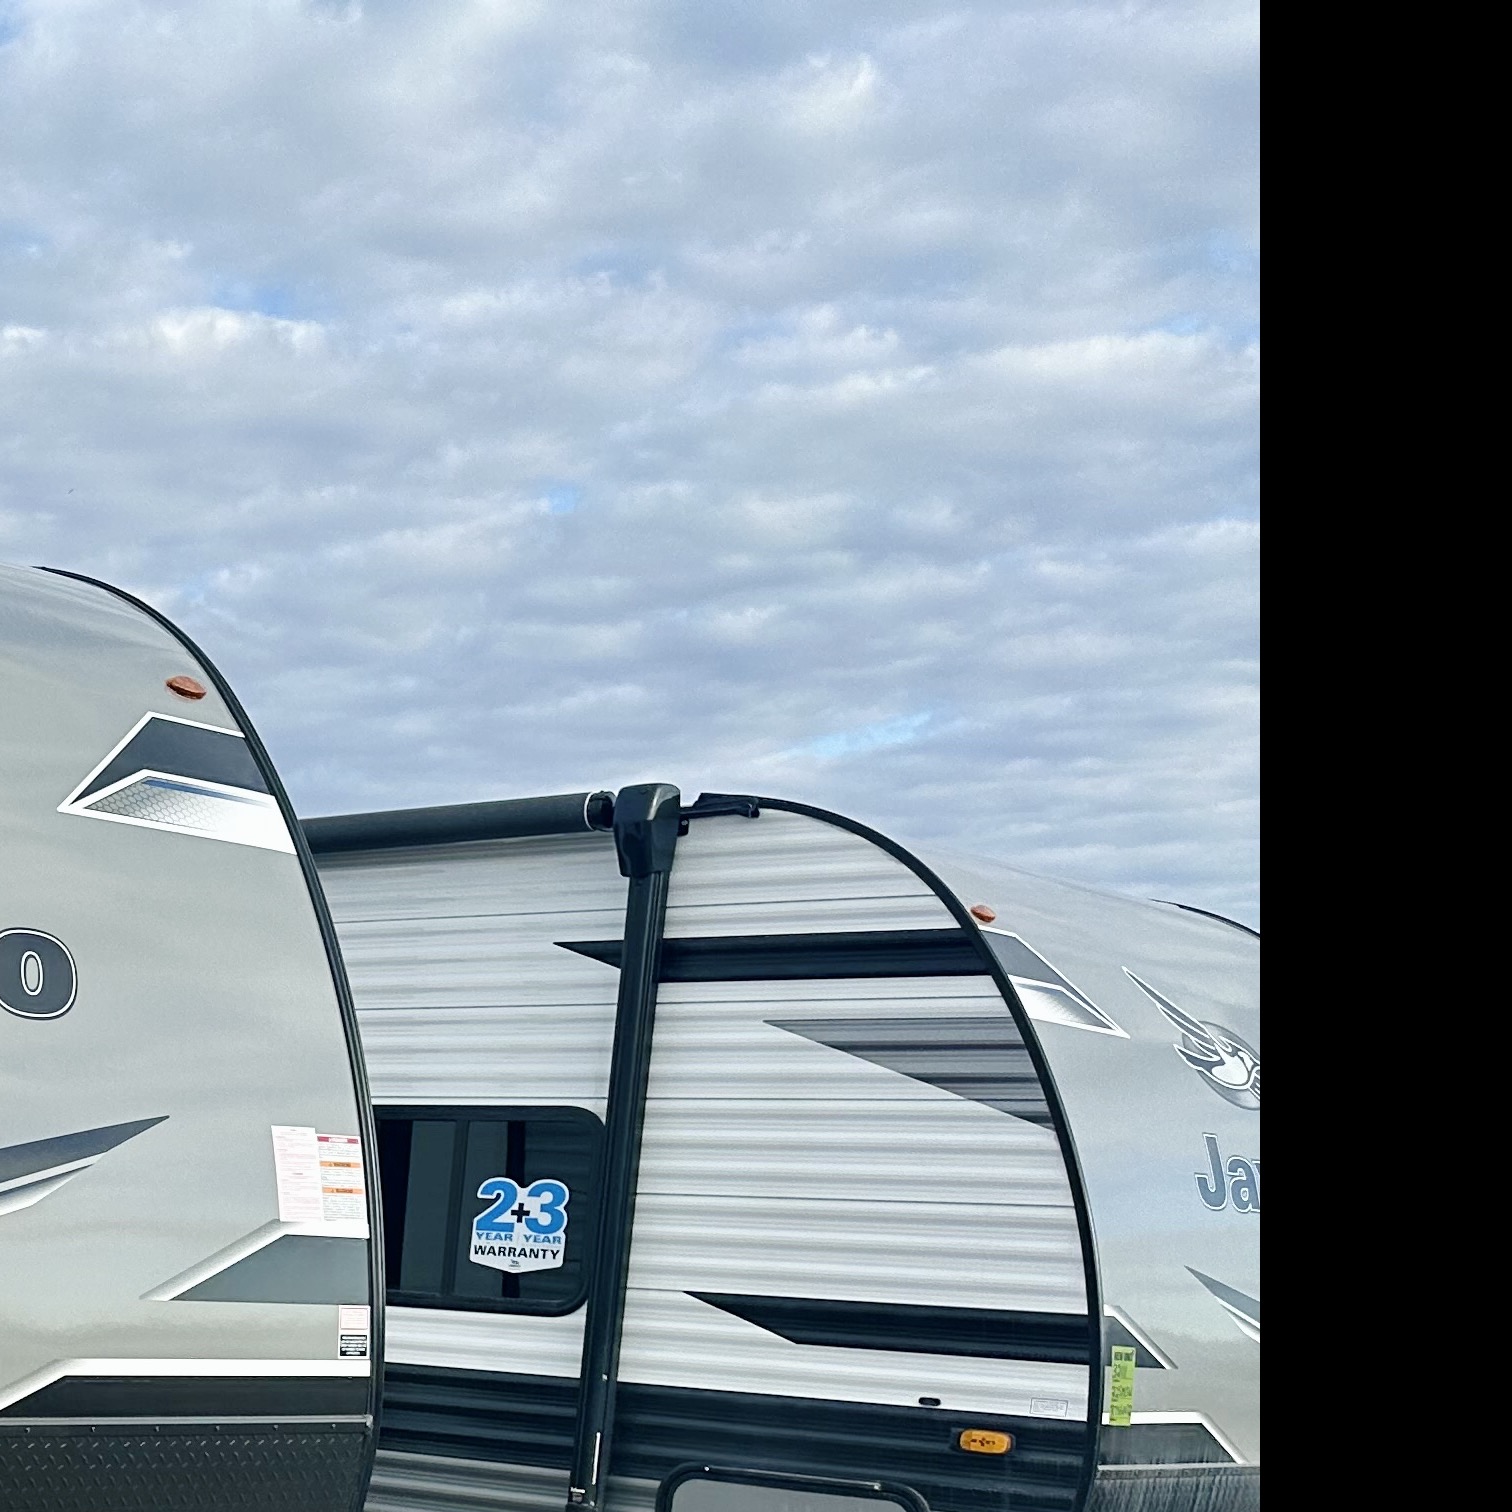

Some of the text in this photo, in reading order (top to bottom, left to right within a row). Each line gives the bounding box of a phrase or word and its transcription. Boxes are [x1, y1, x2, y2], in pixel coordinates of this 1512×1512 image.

[1194, 1132, 1260, 1214] Ja
[476, 1232, 562, 1245] YEAR YEAR
[474, 1245, 560, 1259] WARRANTY
